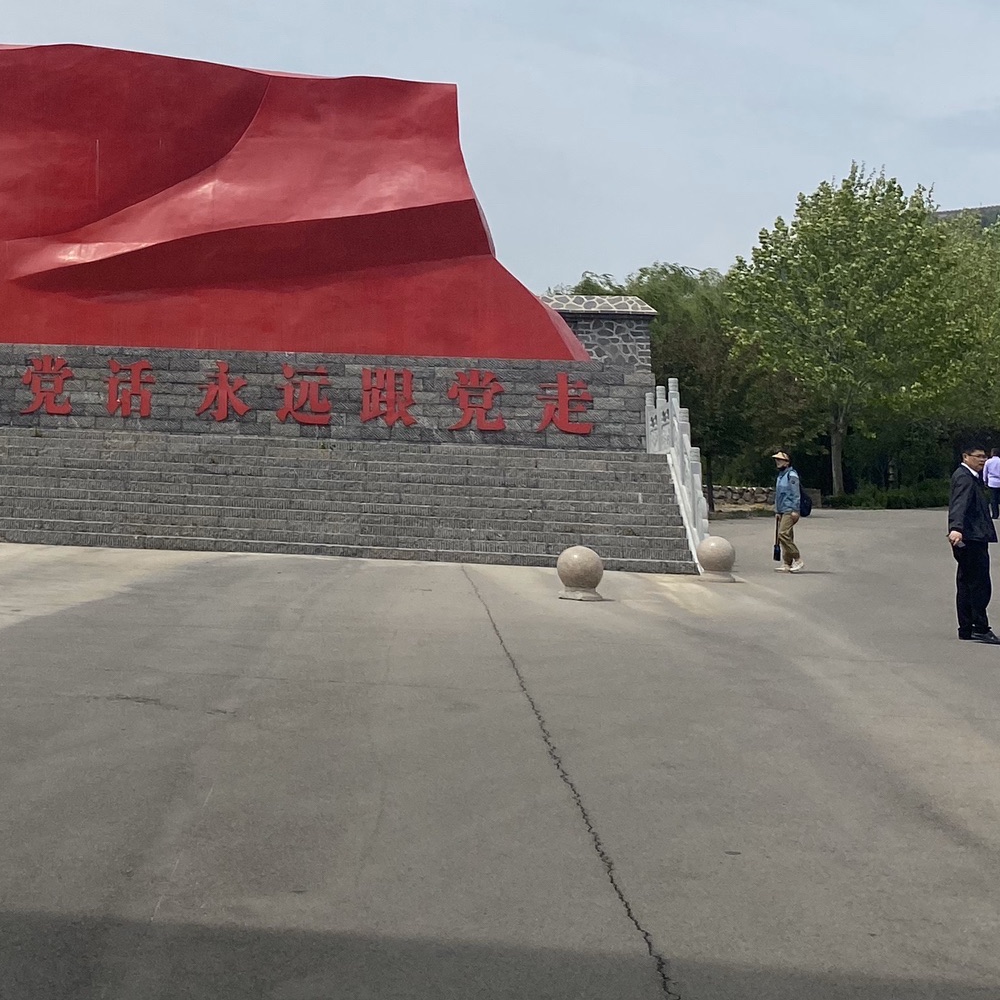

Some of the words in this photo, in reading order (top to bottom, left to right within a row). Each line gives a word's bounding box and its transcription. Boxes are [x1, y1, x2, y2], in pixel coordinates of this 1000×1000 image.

[196, 360, 593, 434] 永远跟党走
